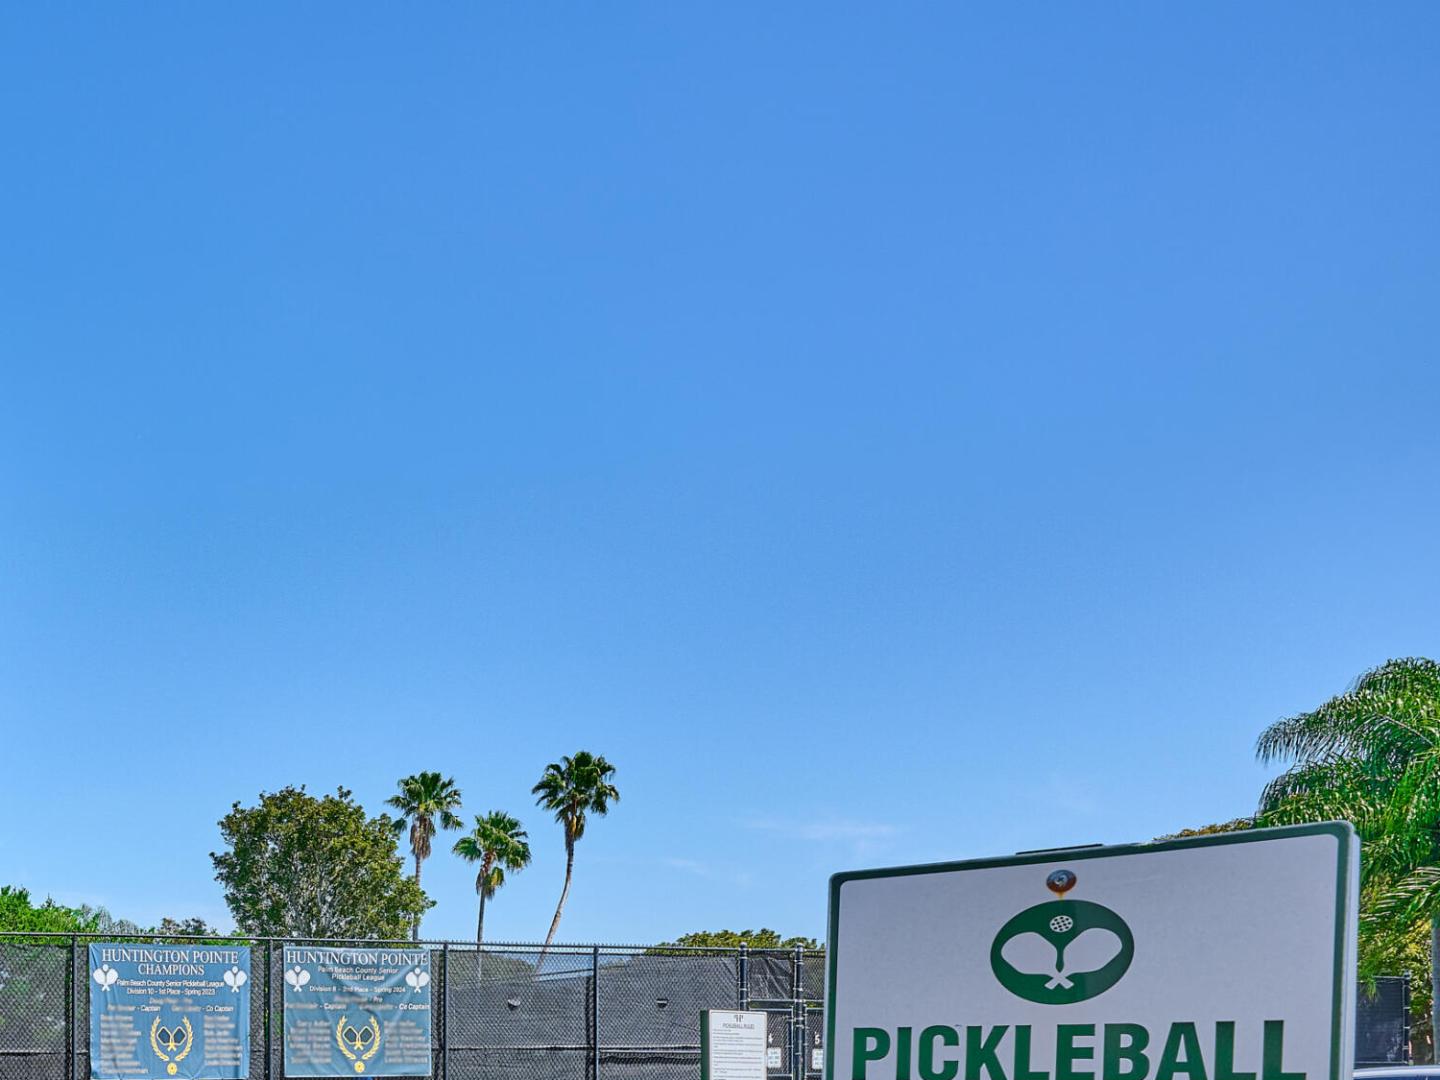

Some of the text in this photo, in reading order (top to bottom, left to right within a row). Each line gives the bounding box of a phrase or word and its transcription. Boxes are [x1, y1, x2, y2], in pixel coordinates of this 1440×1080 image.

[102, 949, 239, 964] HUNTINGTON POINTE
[287, 951, 428, 965] HUNTINGTON POINTE
[138, 964, 205, 975] CHAMPIONS
[355, 967, 377, 975] County
[363, 974, 385, 982] League
[147, 980, 165, 988] County
[206, 980, 224, 988] League
[184, 988, 201, 996] Spring
